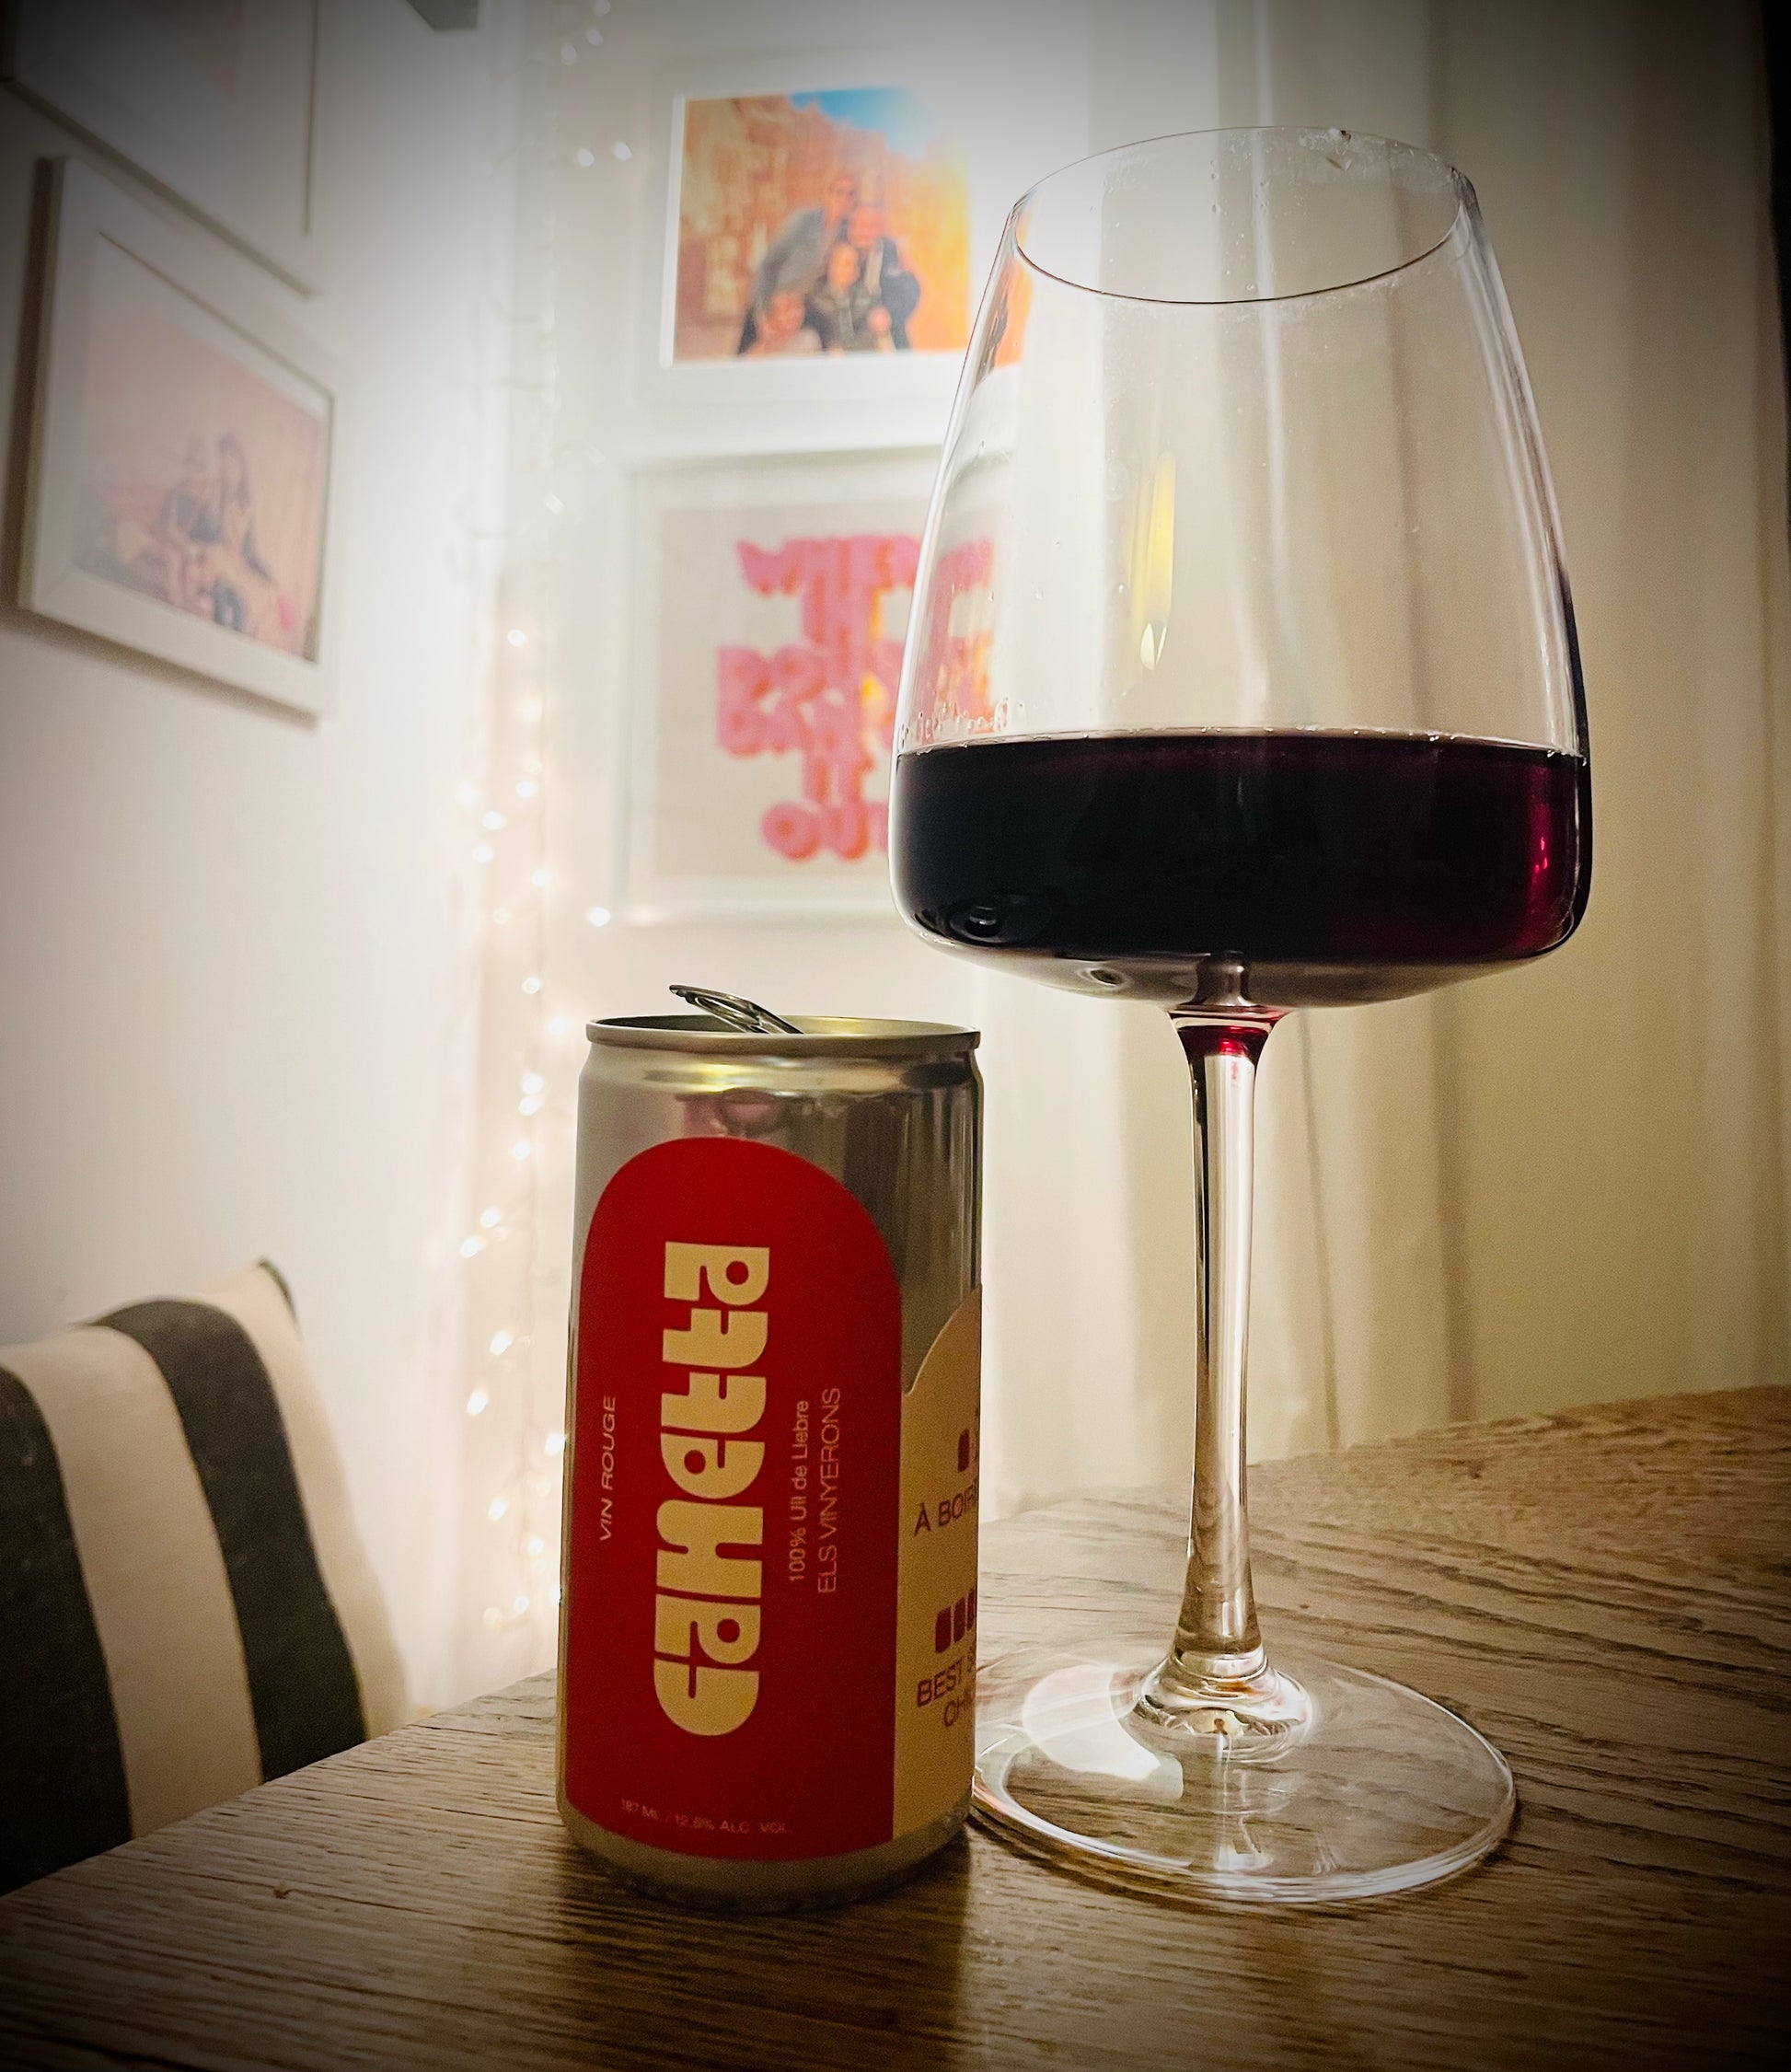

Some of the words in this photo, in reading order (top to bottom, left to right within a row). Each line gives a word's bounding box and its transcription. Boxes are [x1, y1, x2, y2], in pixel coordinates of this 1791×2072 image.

[602, 1395, 617, 1491] ROUGE
[819, 1387, 841, 1541] VINYERONS
[793, 1464, 809, 1491] de
[599, 1499, 614, 1541] VIN
[788, 1526, 808, 1582] 100%
[817, 1544, 838, 1593] ELS
[917, 1657, 963, 1708] BEST
